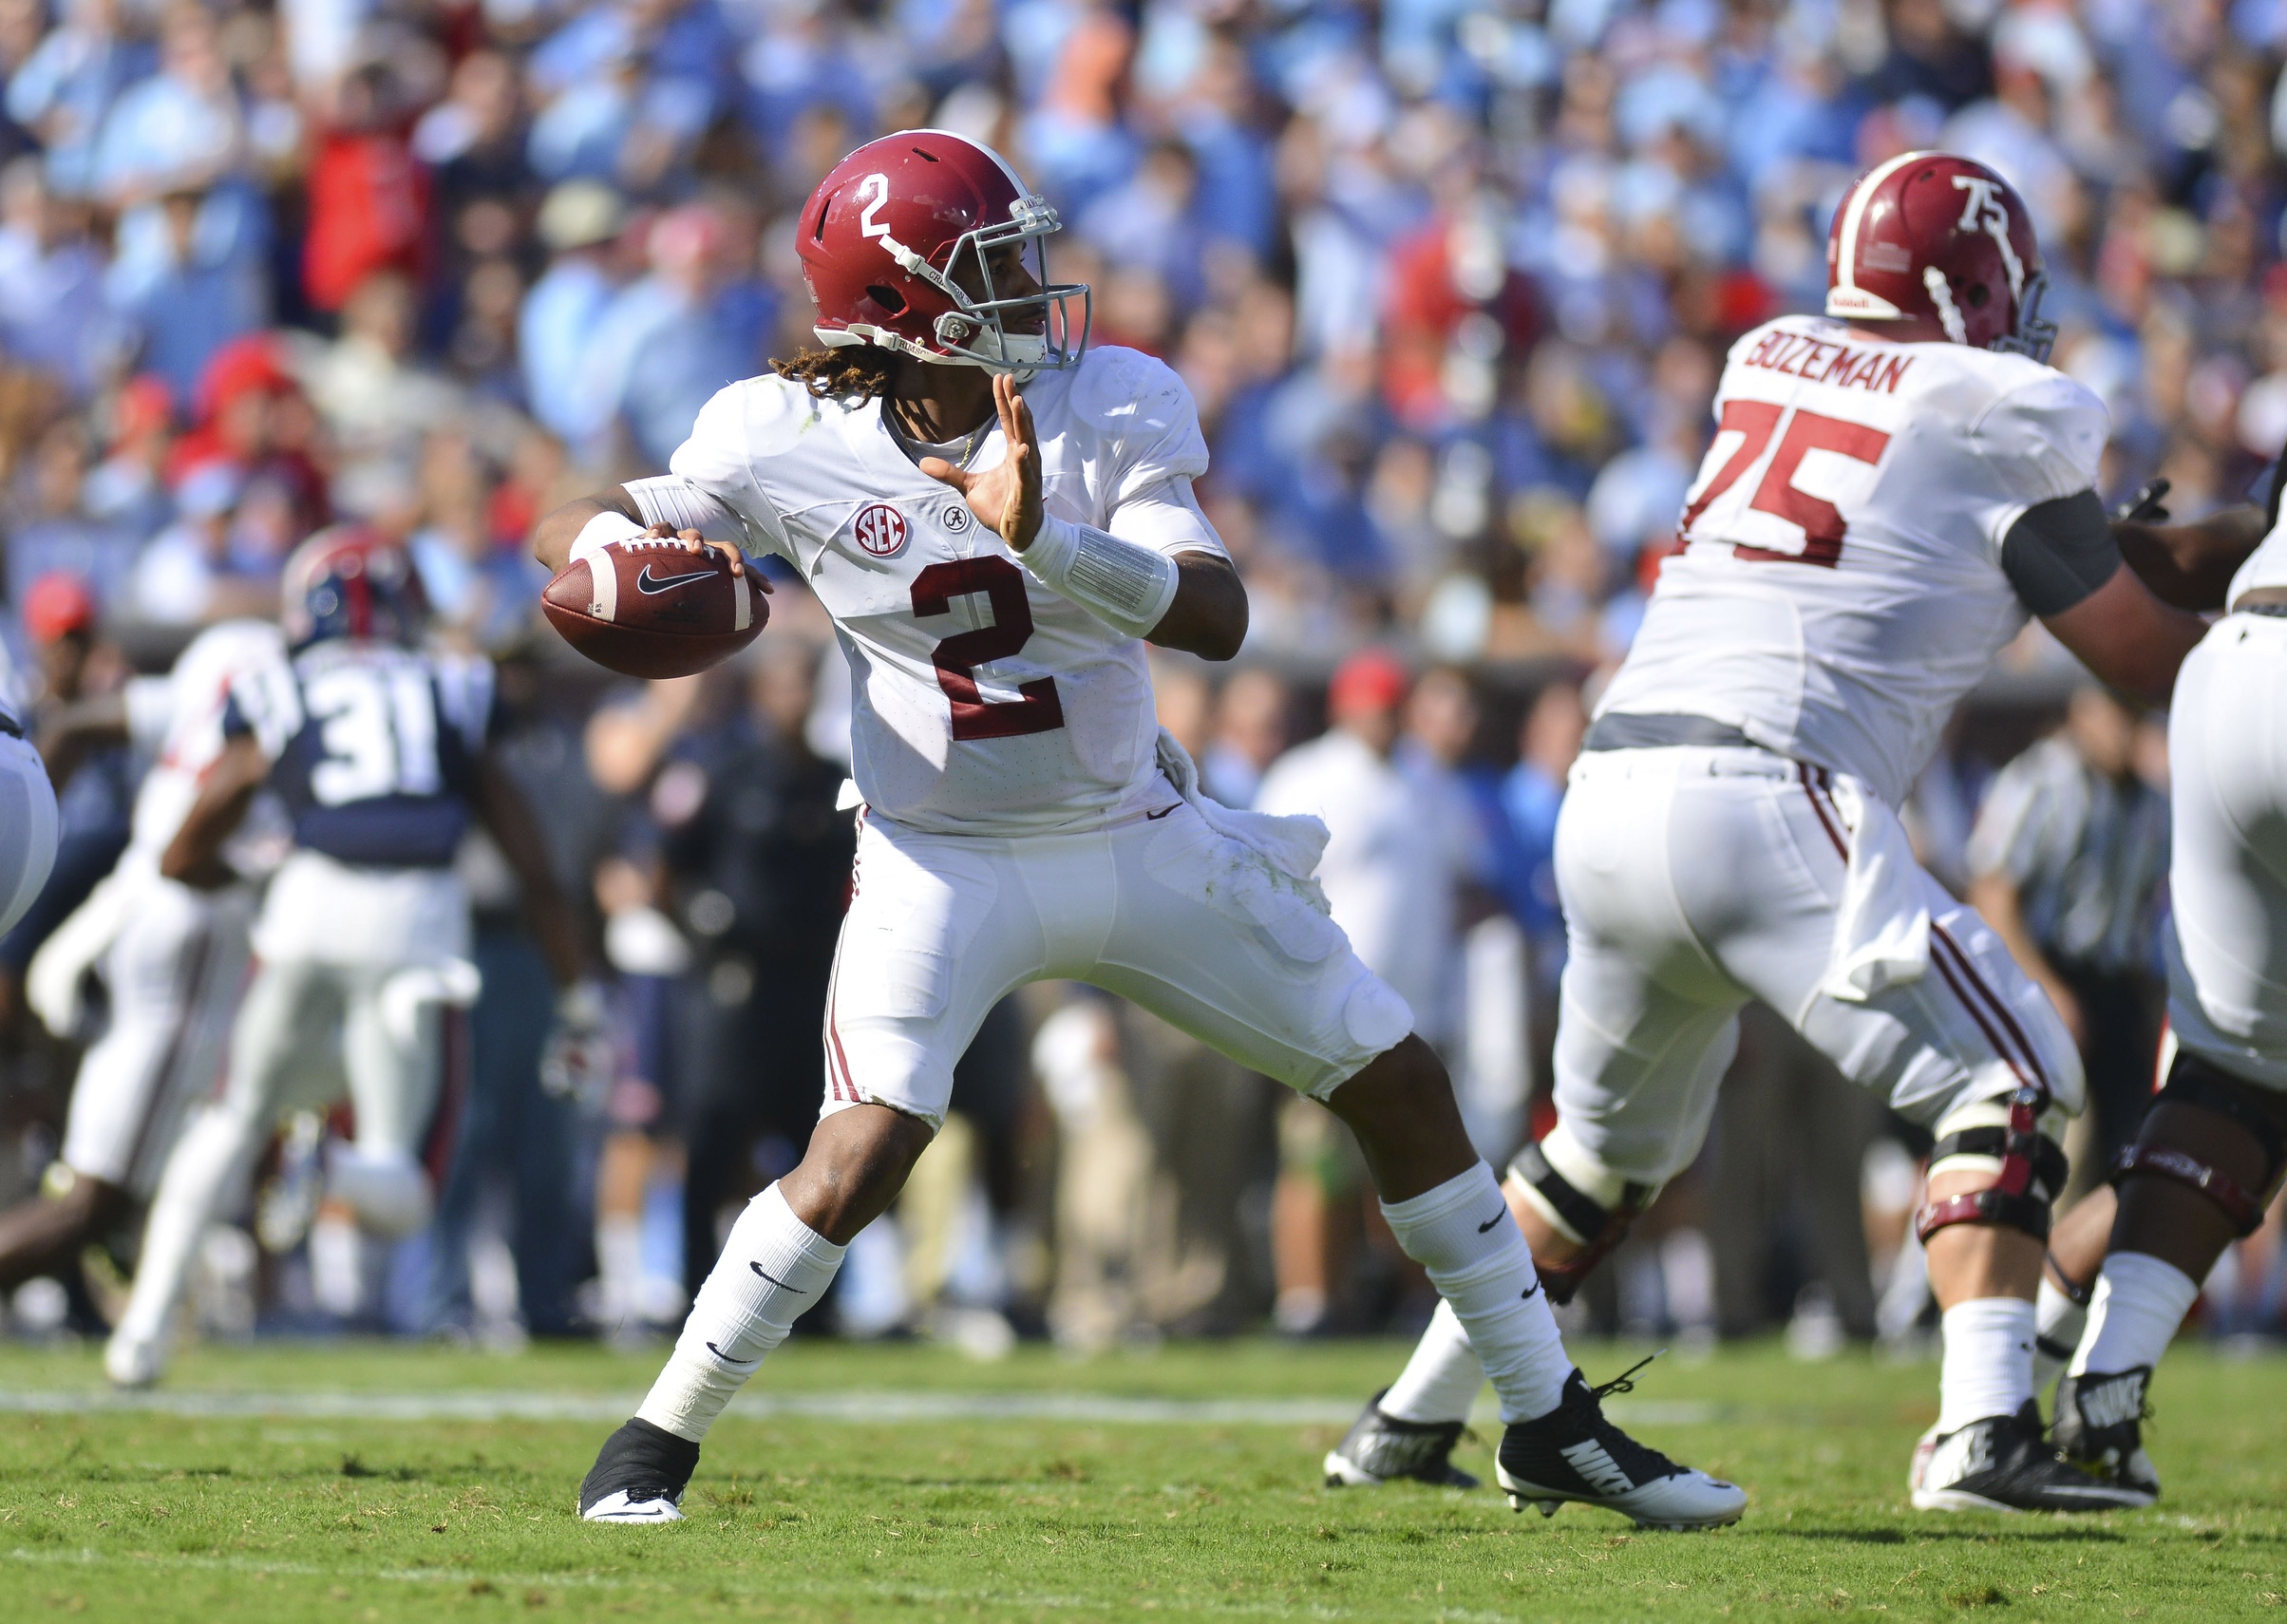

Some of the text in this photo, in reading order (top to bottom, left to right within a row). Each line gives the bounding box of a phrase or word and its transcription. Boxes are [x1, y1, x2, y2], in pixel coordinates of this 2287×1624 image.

[860, 173, 890, 237] 2
[1951, 175, 2009, 236] 75
[1745, 330, 1916, 394] BOZEMAN
[1670, 400, 1892, 571] 75
[859, 507, 902, 552] SEC
[909, 554, 1065, 741] 2
[304, 667, 442, 807] 31
[1559, 1438, 1635, 1497] NIKE
